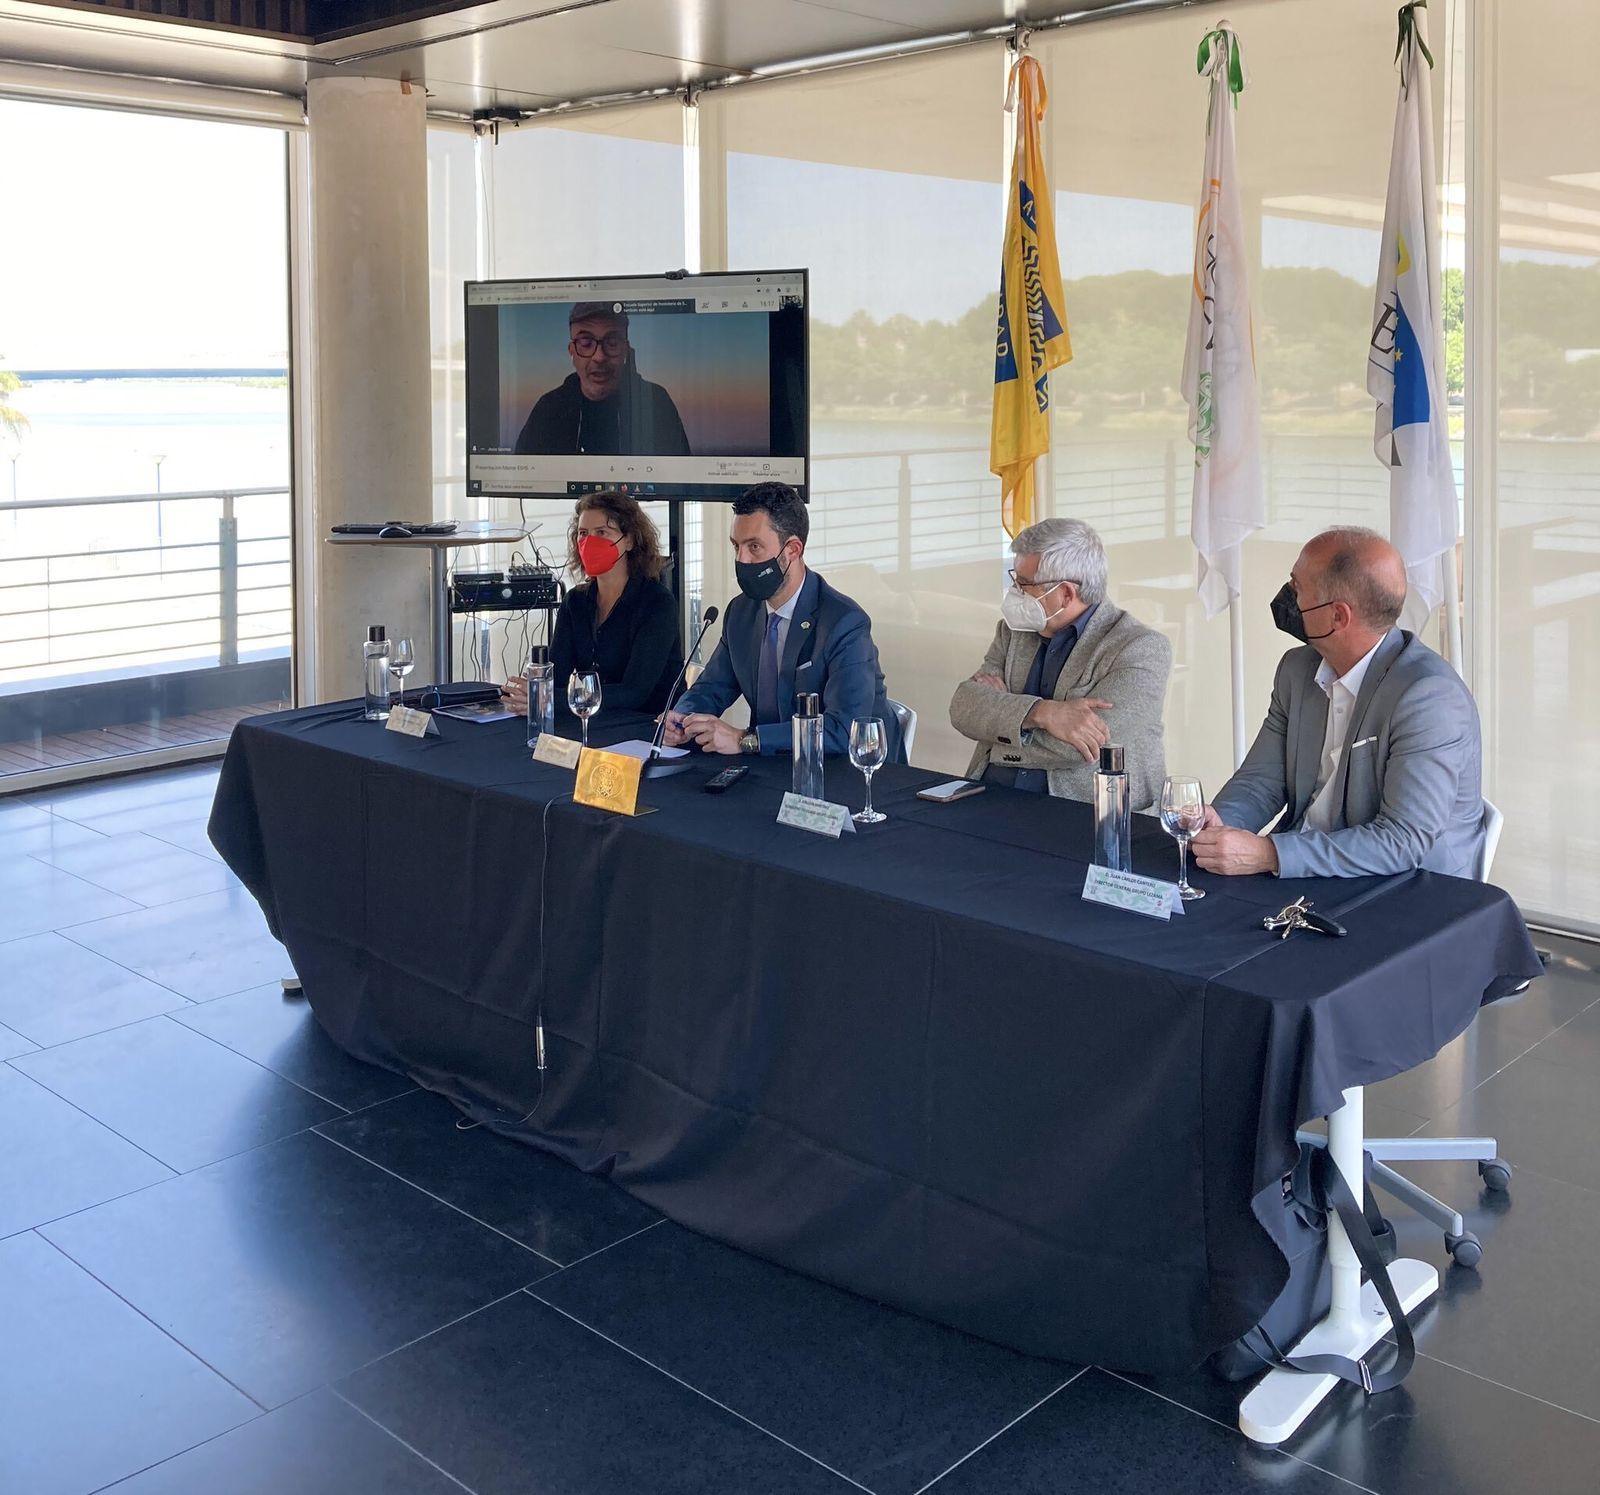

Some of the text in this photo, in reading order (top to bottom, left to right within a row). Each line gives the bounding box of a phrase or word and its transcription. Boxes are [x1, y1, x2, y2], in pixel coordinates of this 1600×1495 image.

[1121, 875, 1137, 884] CARLOS
[1137, 880, 1156, 888] CANTERO
[1114, 884, 1132, 892] GENERAL
[1132, 887, 1147, 896] GRUPO
